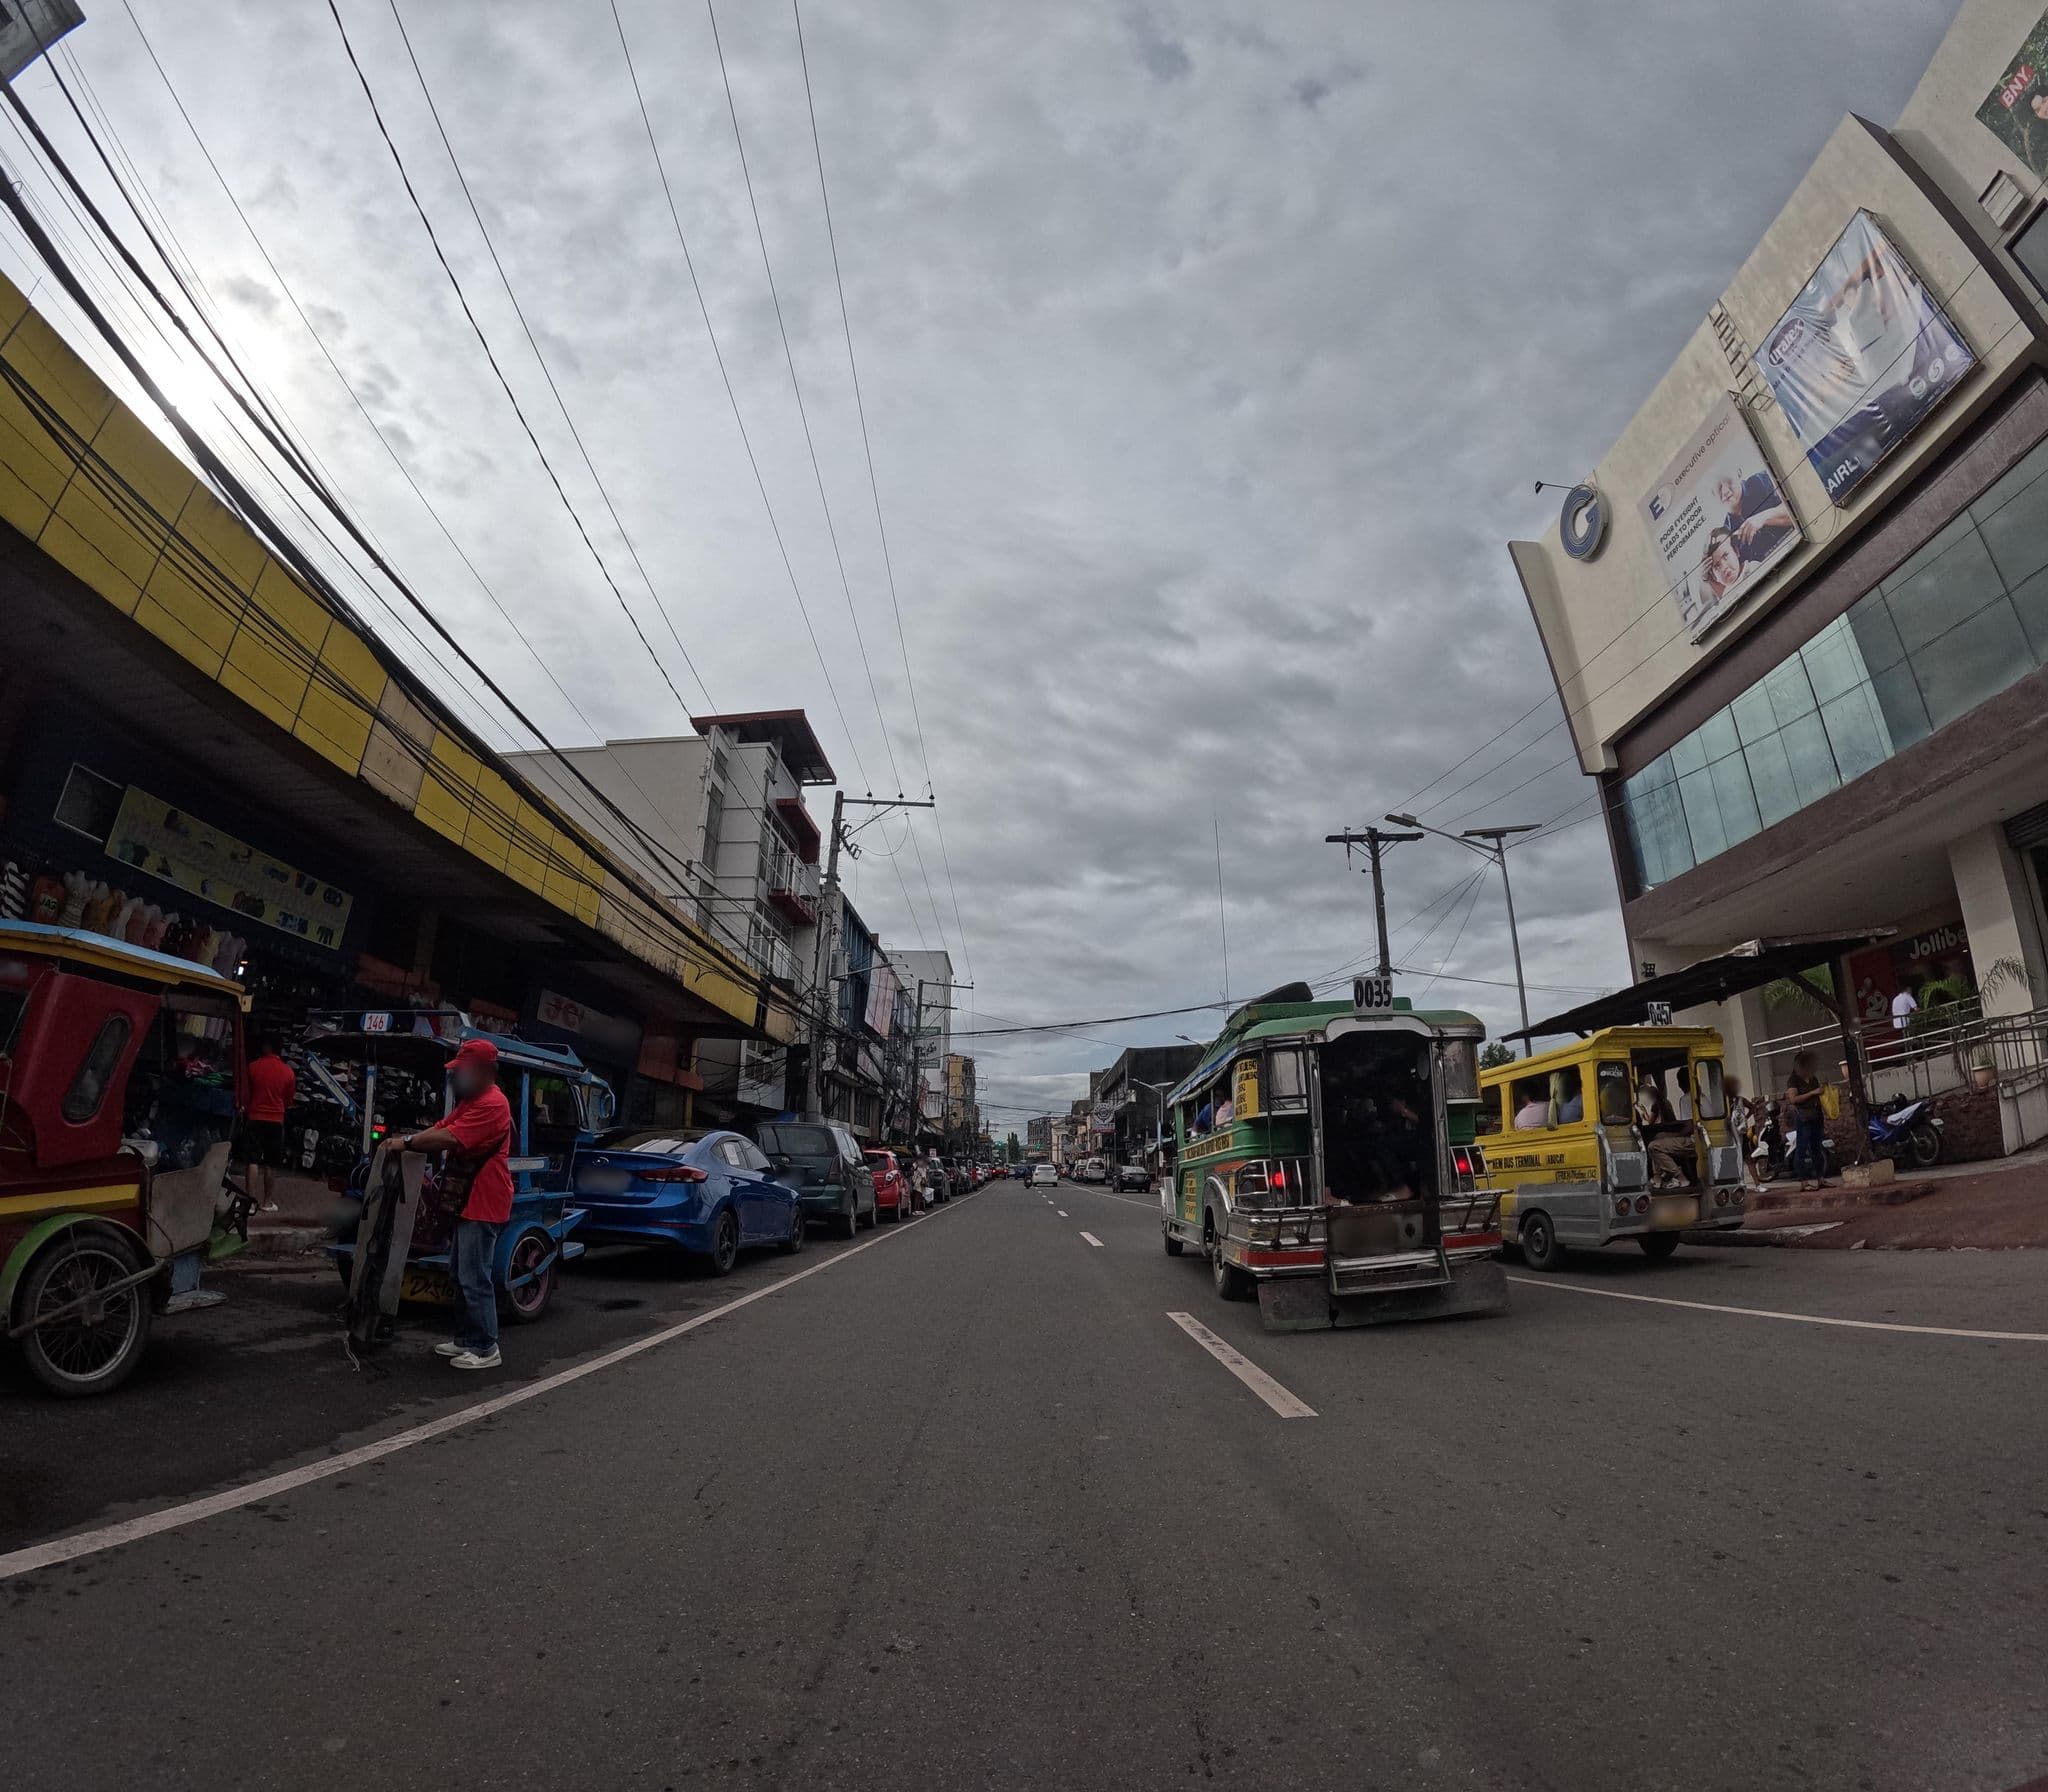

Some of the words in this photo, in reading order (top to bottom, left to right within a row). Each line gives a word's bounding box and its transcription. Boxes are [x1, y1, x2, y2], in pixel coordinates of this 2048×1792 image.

[1674, 445, 1706, 485] executive
[1660, 523, 1675, 543] POOR
[1674, 496, 1698, 527] EYESIGHT
[1663, 531, 1680, 552] LEADS
[1679, 522, 1687, 534] TO
[1686, 505, 1702, 525] POOR
[1354, 979, 1392, 1008] 0035
[366, 1015, 384, 1030] 146
[1503, 1157, 1514, 1169] BUS
[1514, 1154, 1541, 1168] TERMINAL
